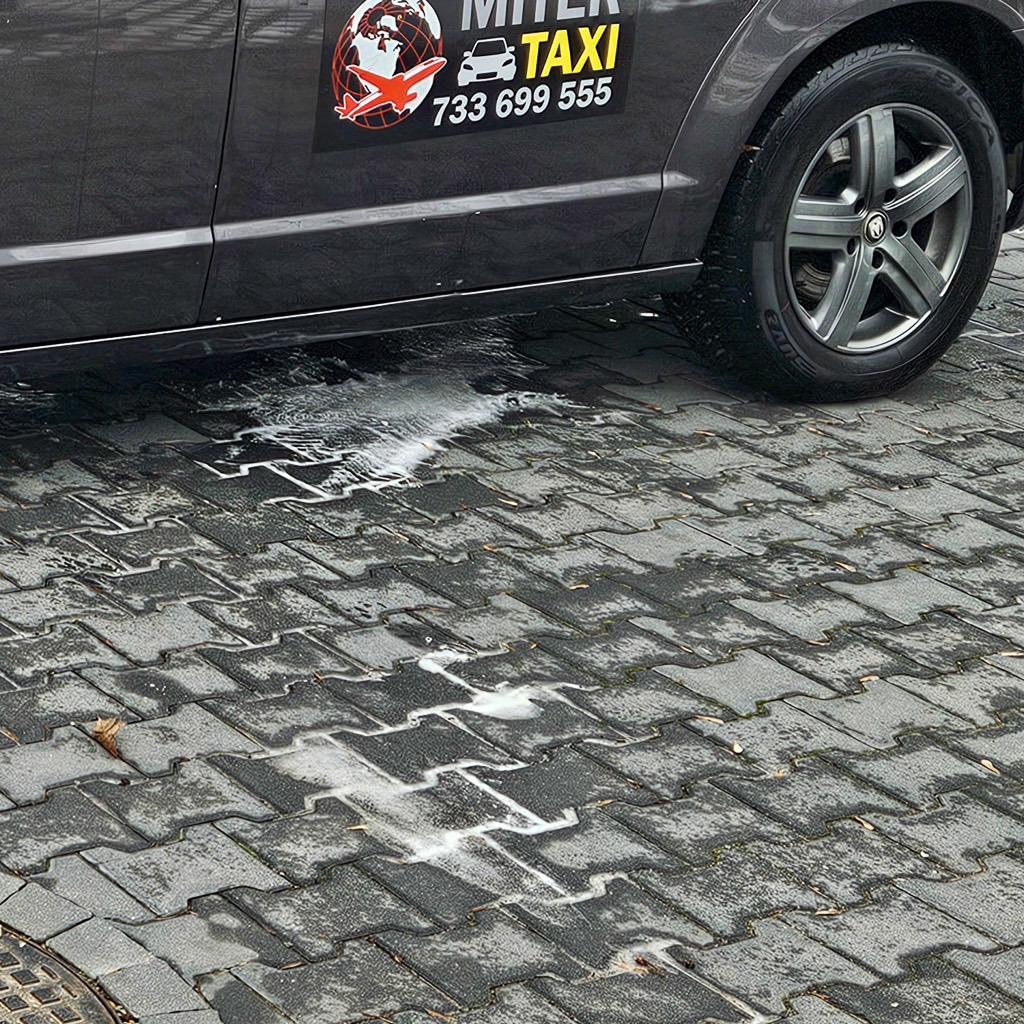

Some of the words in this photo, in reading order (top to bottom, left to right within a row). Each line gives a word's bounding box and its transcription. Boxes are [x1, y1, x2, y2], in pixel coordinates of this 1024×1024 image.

[521, 23, 620, 81] TAXI
[432, 91, 487, 127] 733
[495, 84, 551, 119] 699
[557, 77, 613, 111] 555
